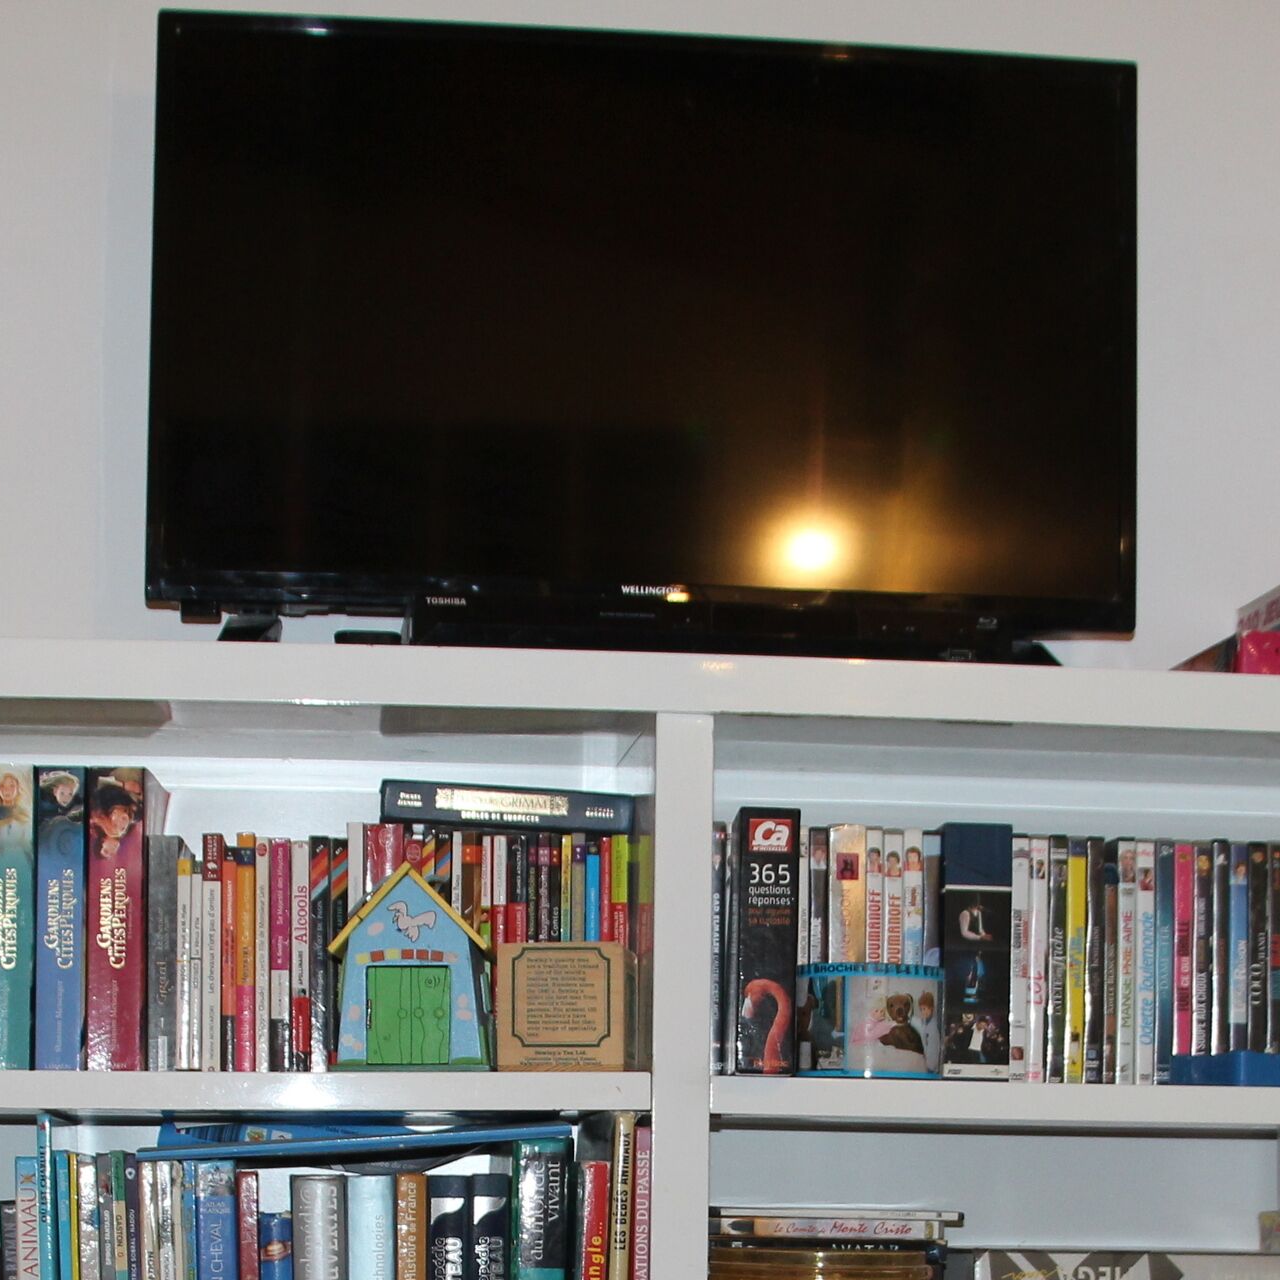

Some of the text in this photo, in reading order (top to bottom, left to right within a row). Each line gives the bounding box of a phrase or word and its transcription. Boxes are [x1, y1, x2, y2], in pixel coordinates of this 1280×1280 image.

[426, 596, 466, 606] TOSHIBA
[748, 886, 791, 897] questions
[749, 863, 791, 884] 365
[44, 879, 60, 949] GARDIENS
[96, 878, 113, 948] GARDIENS
[294, 886, 307, 944] Alcools
[551, 907, 559, 936] Contes
[1122, 911, 1132, 1028] MANGE PRIE AIME
[1140, 912, 1153, 1045] Odette Toulemonde
[1196, 971, 1207, 1049] SOUPE AUX CHOUX
[545, 1161, 561, 1221] vivant
[612, 1132, 631, 1251] LES BÉBÉS ANIMAUX
[634, 1151, 649, 1195] PASSÉ
[19, 1172, 40, 1278] ANIMAUX
[406, 1182, 418, 1221] France
[635, 1199, 647, 1221] DU
[4, 1222, 17, 1271] BATMAN
[115, 1214, 123, 1247] GASTON
[210, 1218, 224, 1272] CHEVAL
[409, 1223, 418, 1232] de
